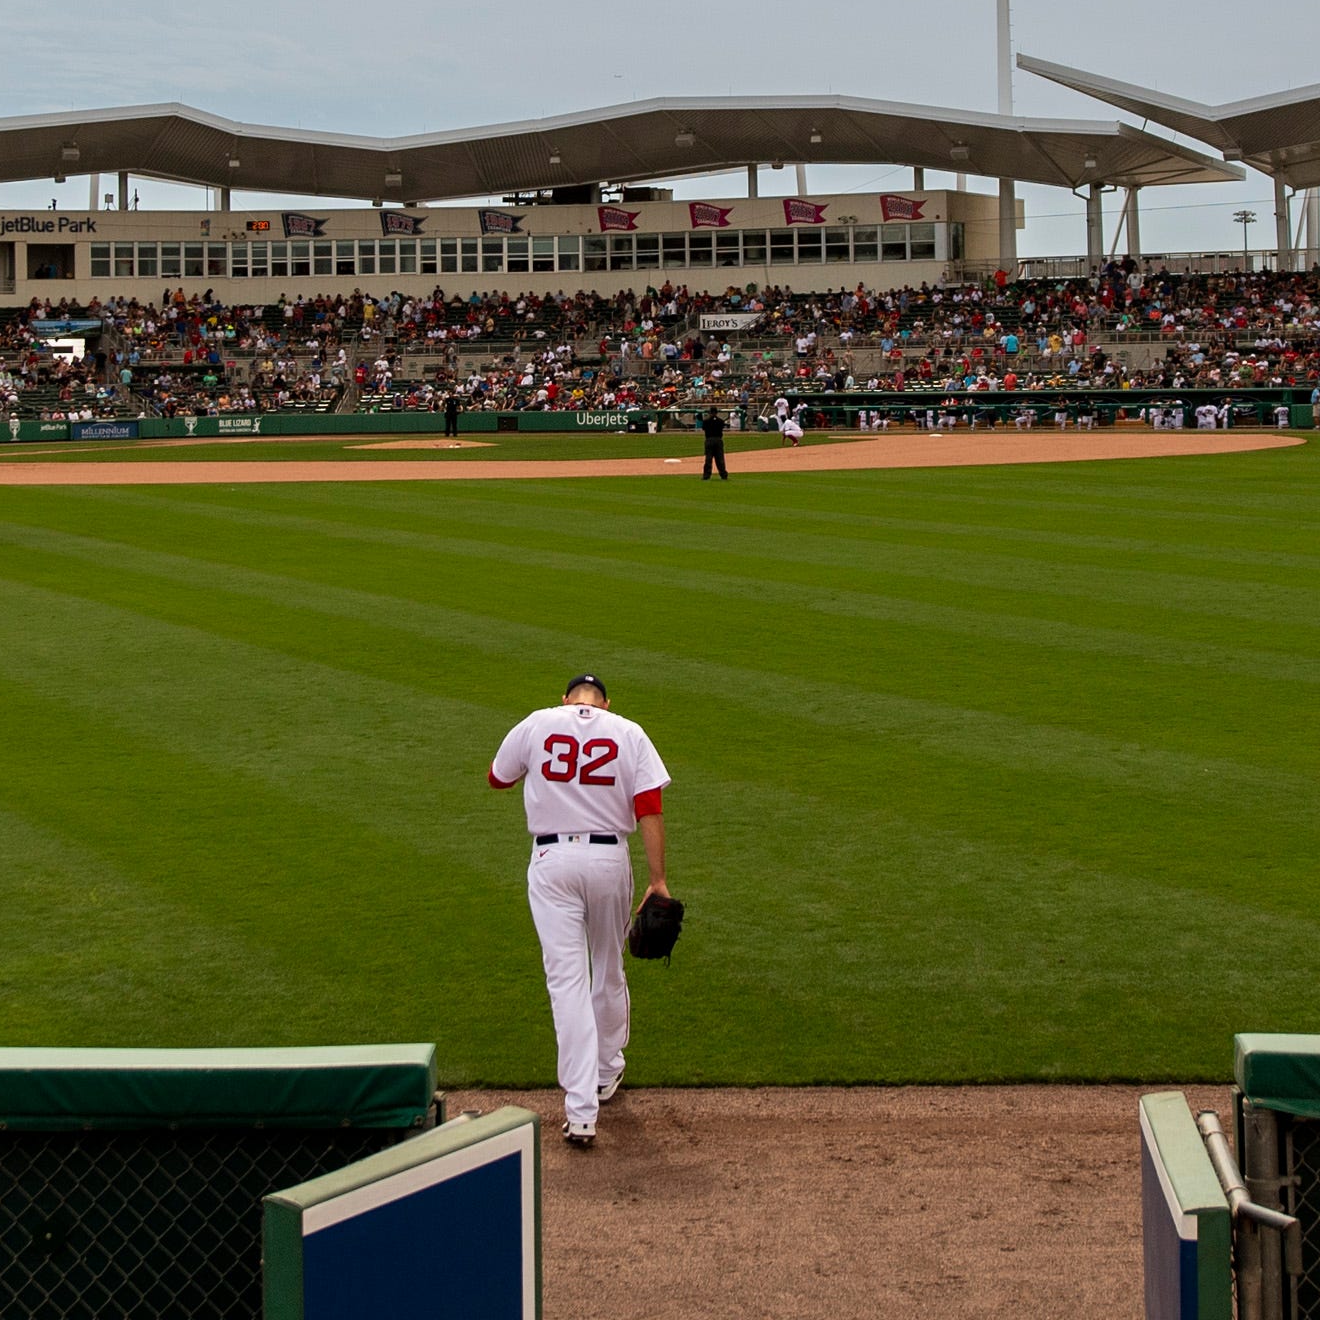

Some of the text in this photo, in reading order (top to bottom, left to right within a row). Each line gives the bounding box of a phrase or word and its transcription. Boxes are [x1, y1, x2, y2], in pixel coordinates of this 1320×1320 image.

[0, 216, 96, 235] jetBlue Park
[218, 419, 251, 427] BLUE LIZARD
[576, 412, 629, 427] UberJets
[542, 733, 619, 786] 32
